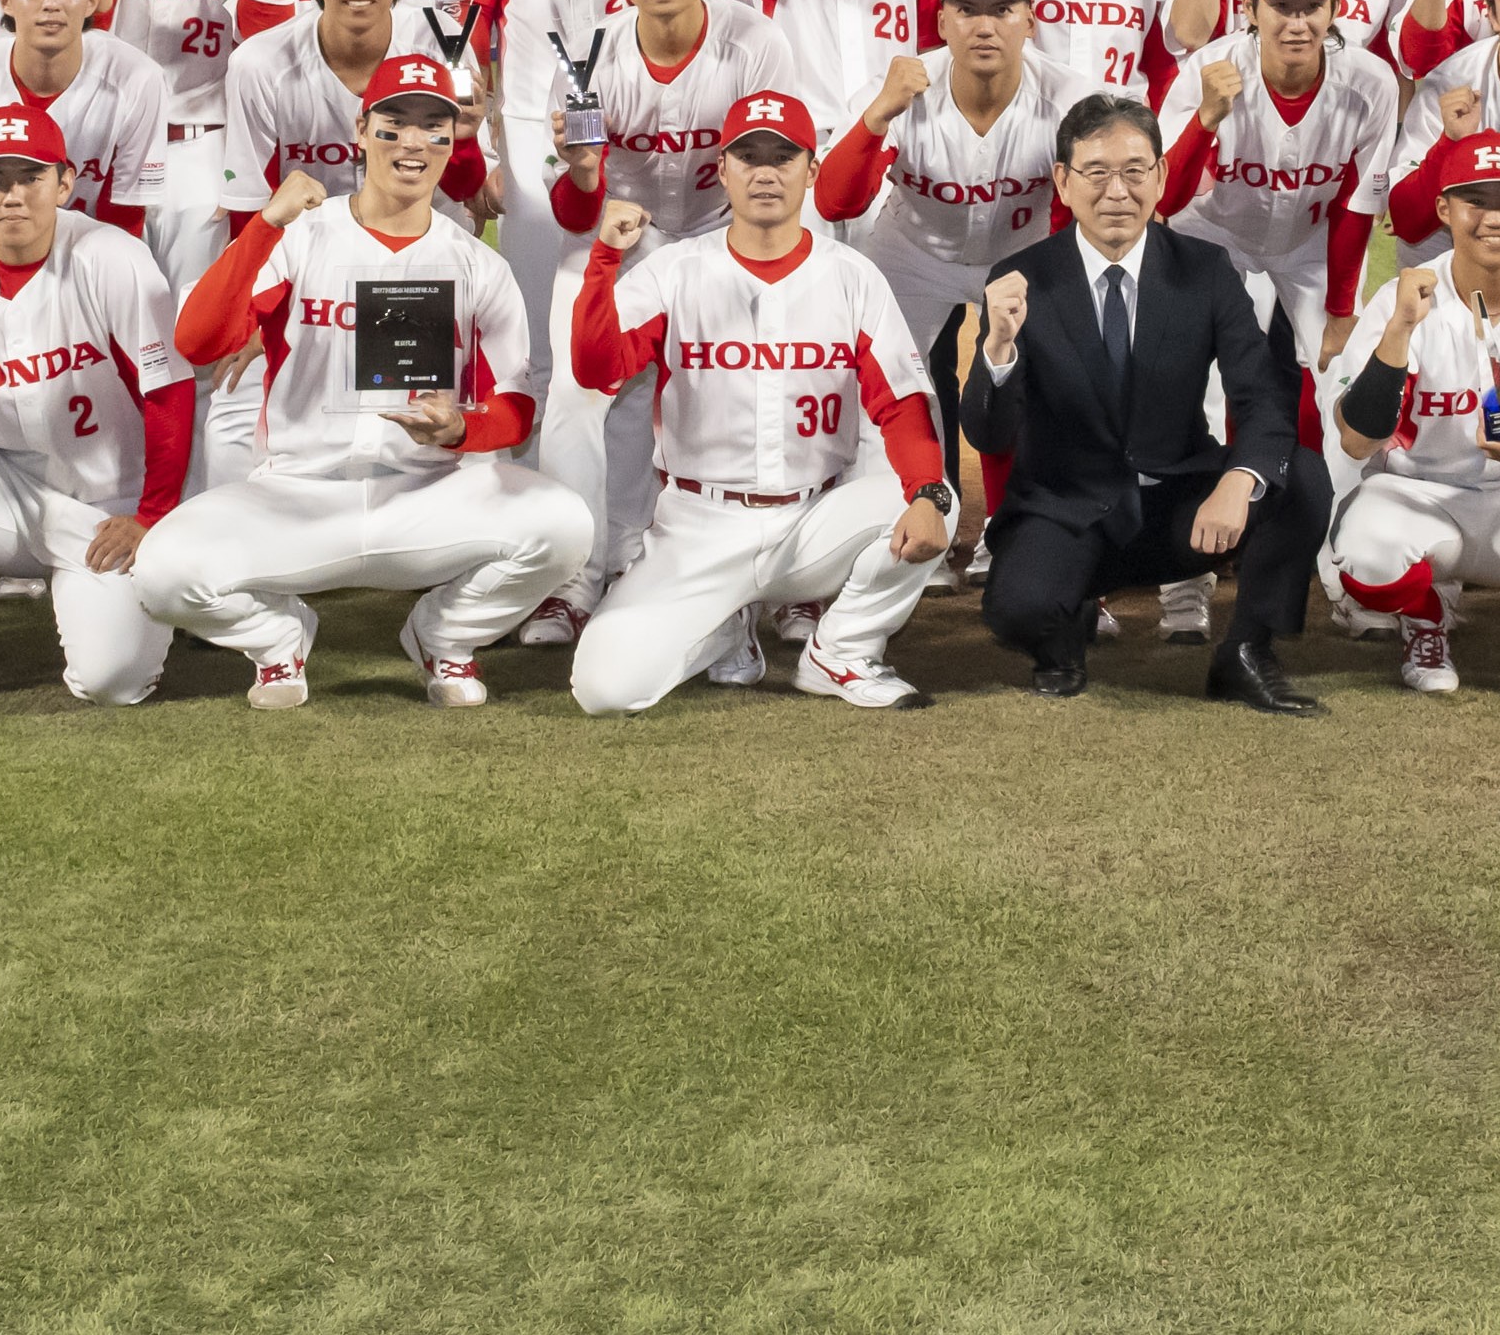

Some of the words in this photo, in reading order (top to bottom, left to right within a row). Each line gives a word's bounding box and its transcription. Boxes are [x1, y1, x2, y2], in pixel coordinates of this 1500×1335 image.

[872, 2, 910, 43] 28
[1035, 0, 1146, 32] ONDA
[182, 17, 226, 58] 25
[1104, 47, 1136, 86] 21
[745, 98, 785, 122] H
[606, 129, 722, 154] HOND
[902, 170, 1050, 206] HONDA
[679, 341, 857, 371] HONDA
[69, 394, 98, 438] 2
[795, 392, 842, 438] 30
